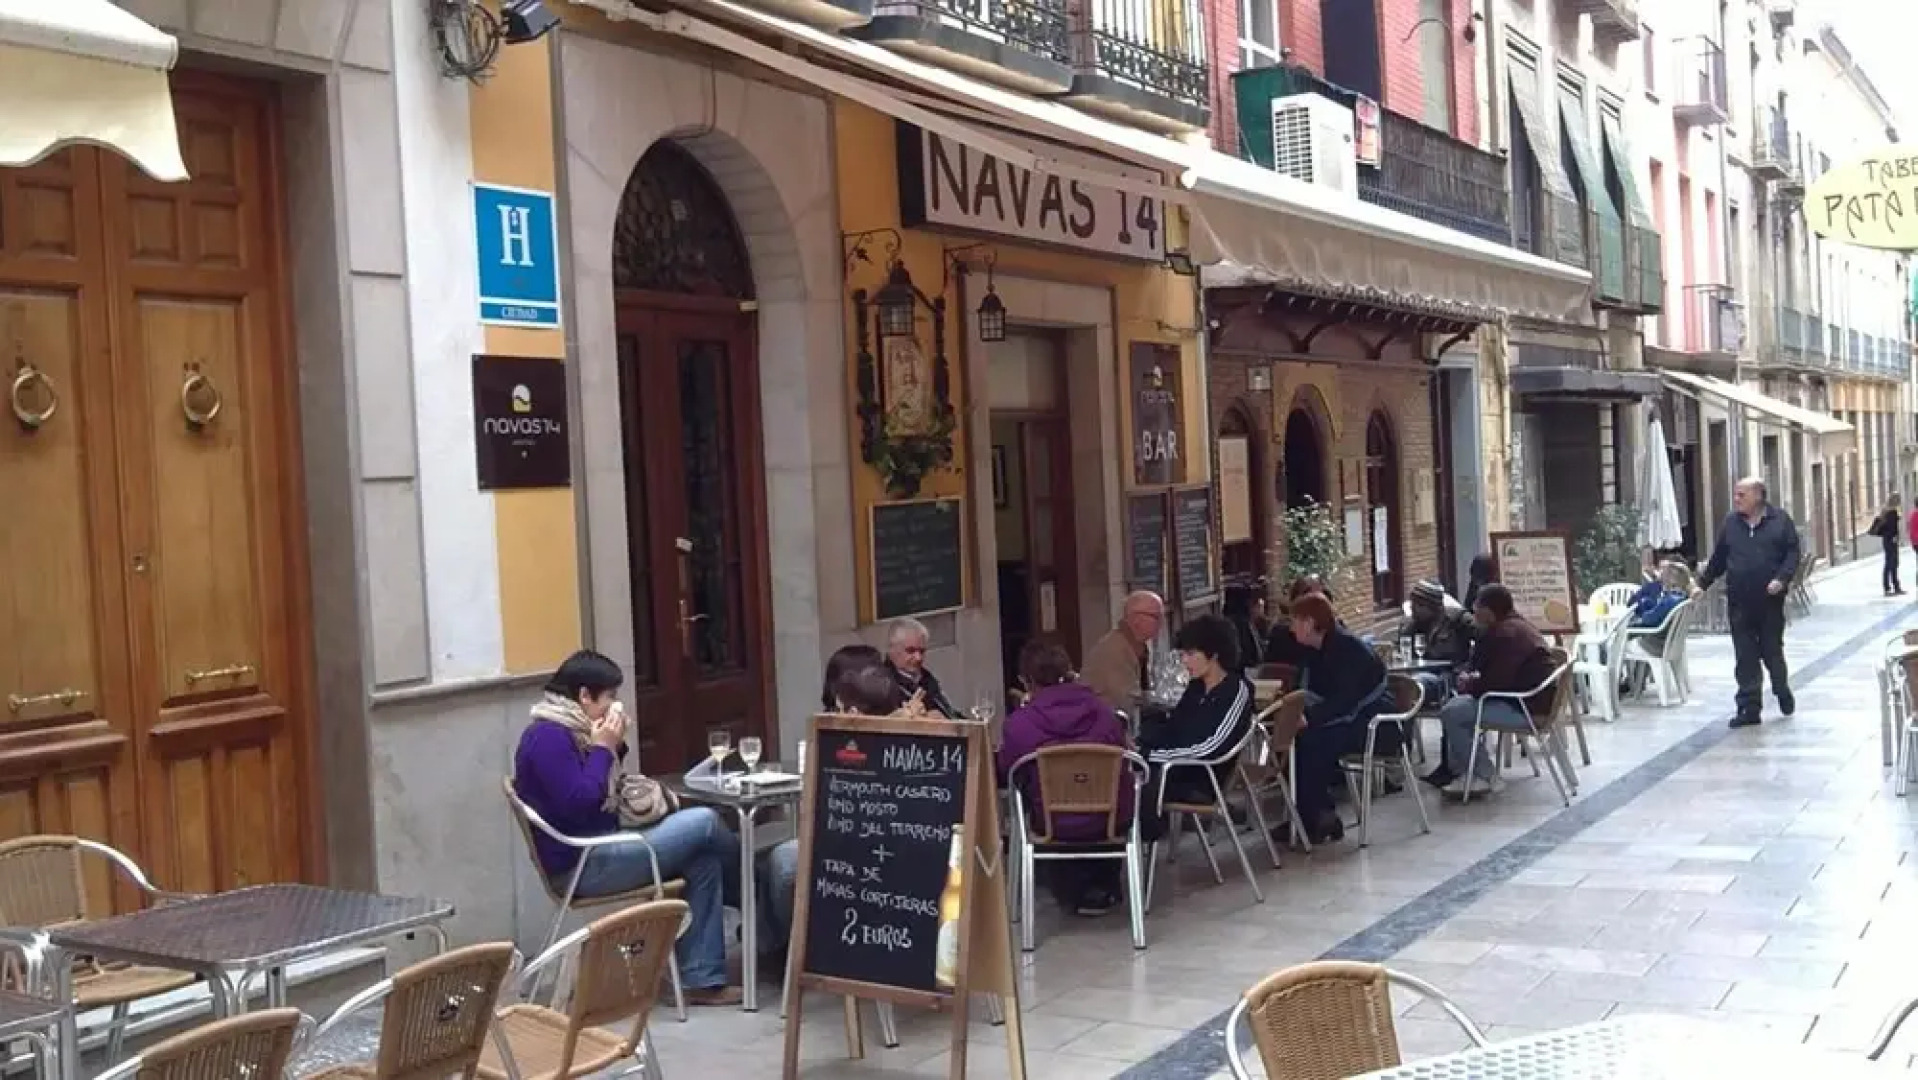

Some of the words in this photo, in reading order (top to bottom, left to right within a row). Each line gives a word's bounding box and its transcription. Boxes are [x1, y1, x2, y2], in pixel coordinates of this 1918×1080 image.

[929, 129, 1095, 238] NAVAS
[1117, 188, 1158, 250] 14
[497, 204, 536, 268] H
[1823, 189, 1904, 239] PATA
[1142, 430, 1179, 462] BAR
[883, 744, 935, 772] NAVAS
[941, 745, 963, 773] 14
[841, 907, 858, 946] 2
[862, 923, 912, 951] EUROS
